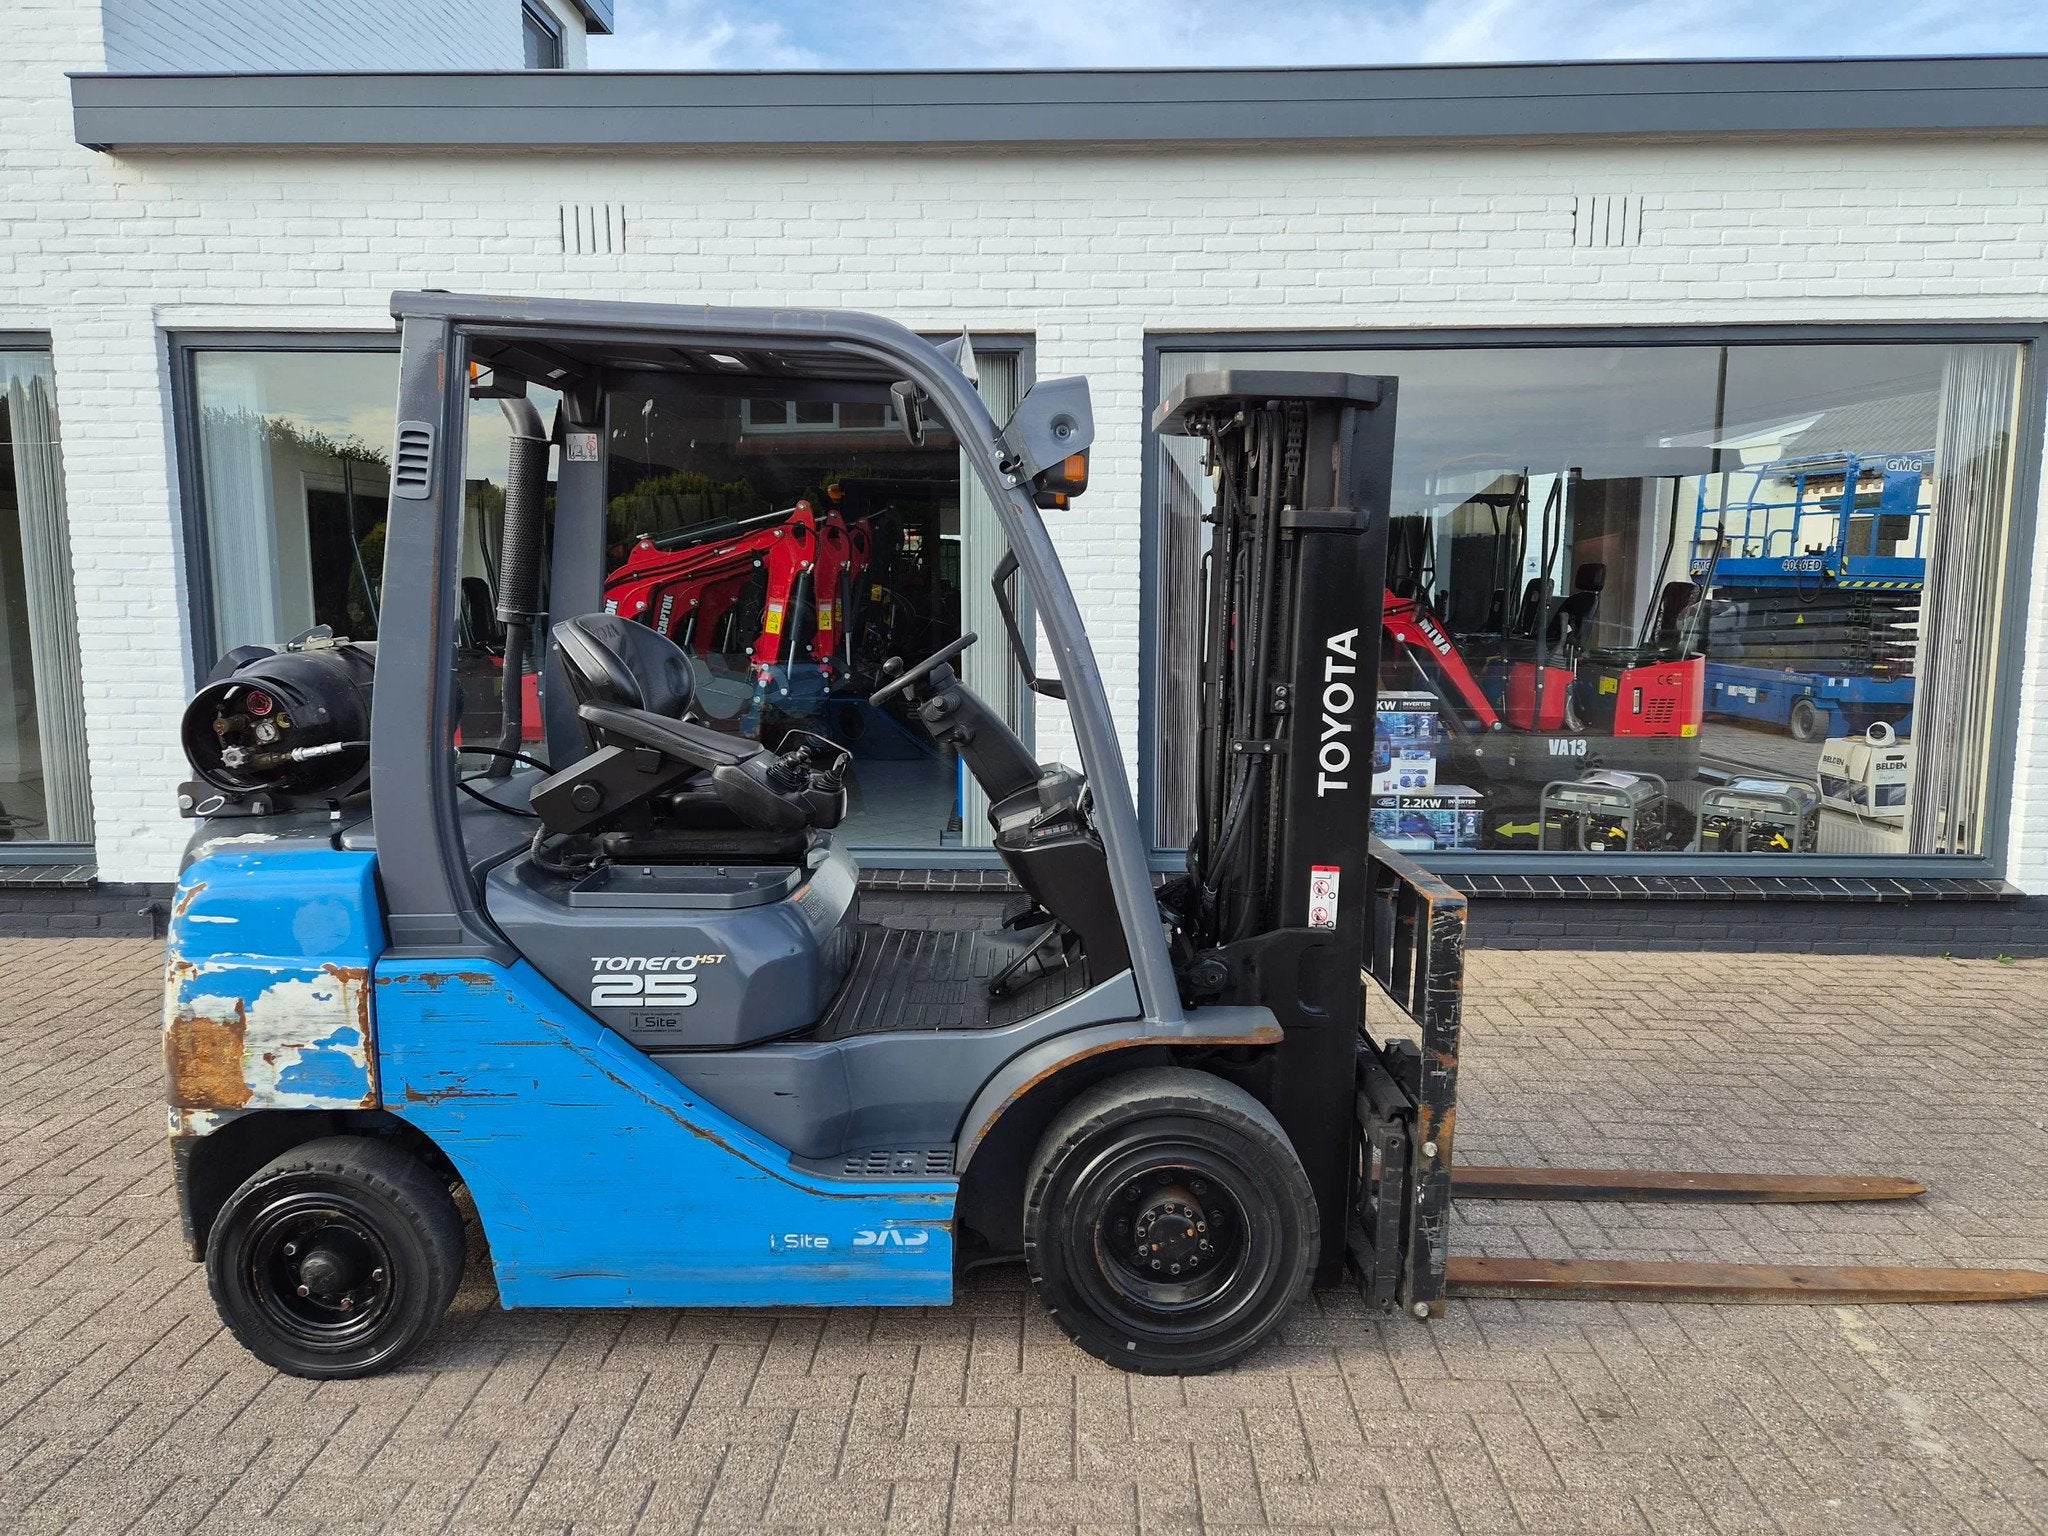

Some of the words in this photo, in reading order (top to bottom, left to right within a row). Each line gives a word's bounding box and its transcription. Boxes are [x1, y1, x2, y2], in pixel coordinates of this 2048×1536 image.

[1886, 459, 1922, 472] GMG
[1419, 618, 1452, 656] MIVA
[1318, 628, 1359, 797] TOYOTA
[1421, 719, 1429, 728] 2
[1549, 739, 1587, 756] VA13
[1876, 762, 1907, 770] BELDEN
[1402, 799, 1441, 808] 2.2KW
[1467, 817, 1475, 826] 2
[695, 954, 726, 964] HST
[591, 974, 698, 1007] 25
